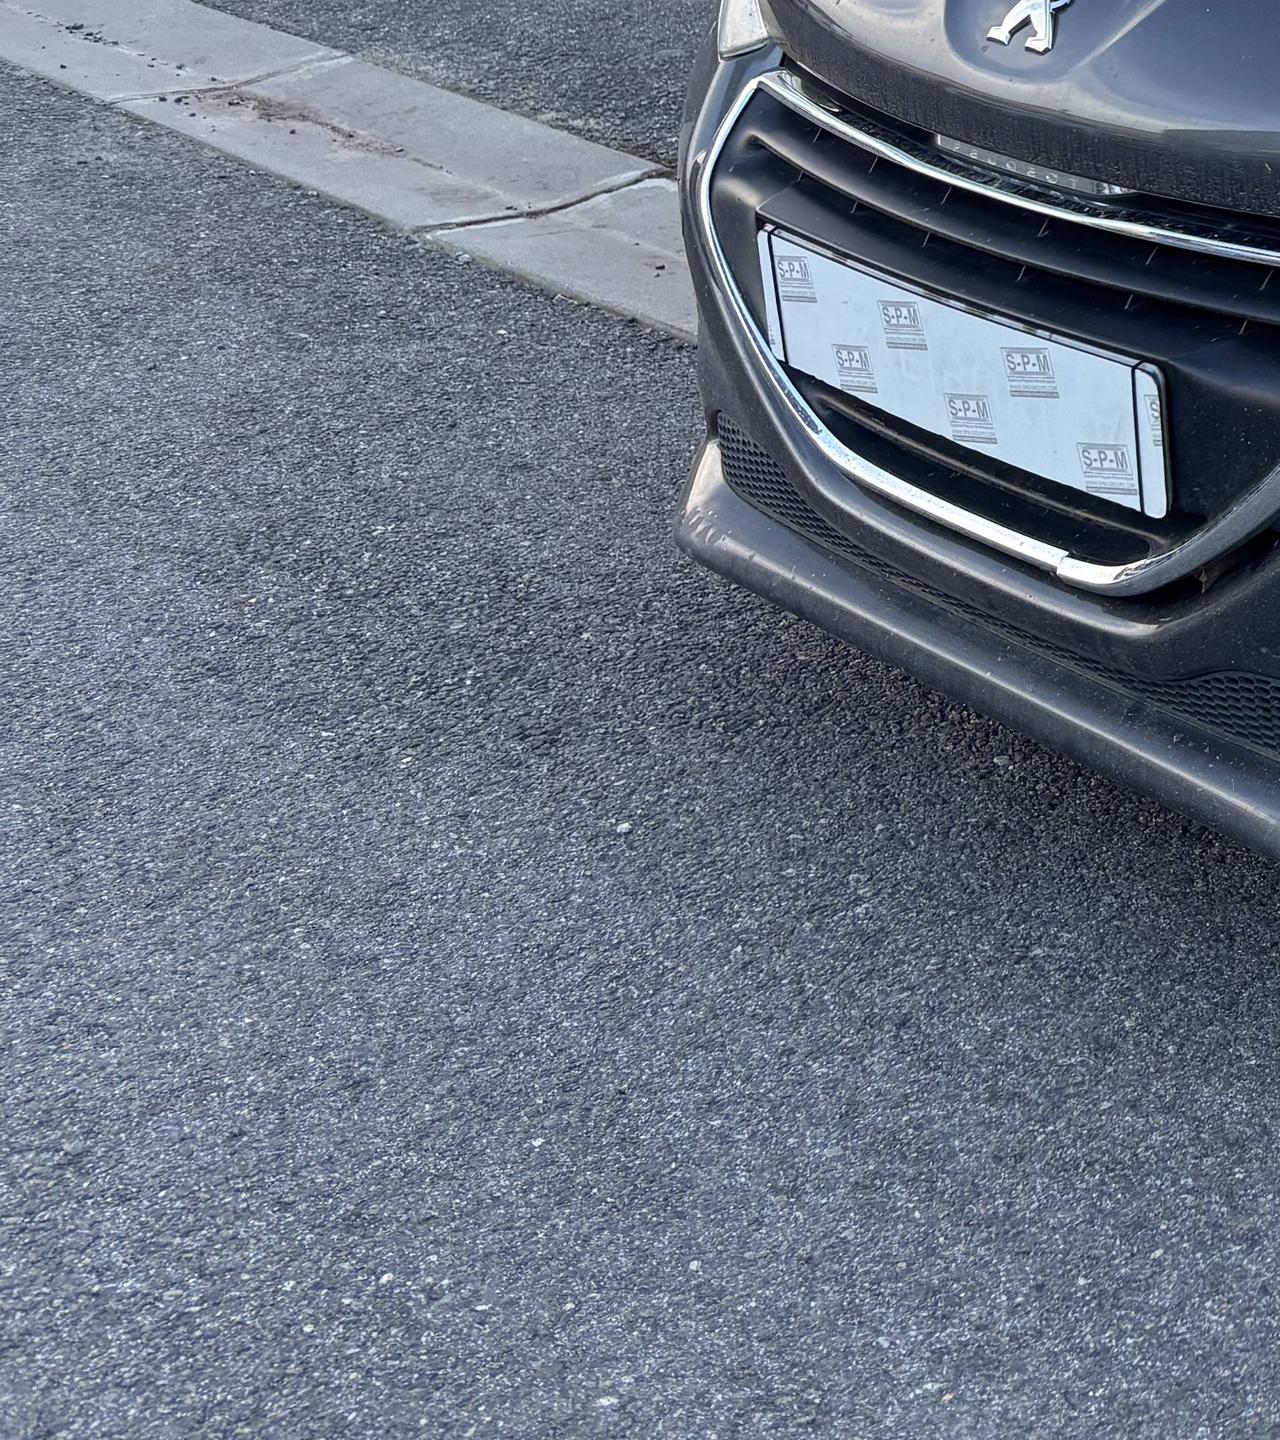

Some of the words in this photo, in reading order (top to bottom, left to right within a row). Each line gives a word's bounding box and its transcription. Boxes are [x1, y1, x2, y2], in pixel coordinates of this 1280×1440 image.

[777, 261, 810, 279] S-P-M
[881, 306, 920, 325] S-P-M
[835, 349, 871, 369] S-P-M
[1005, 353, 1051, 373] S-P-M
[947, 398, 990, 420] S-P-M
[1081, 449, 1129, 470] S-P-M
